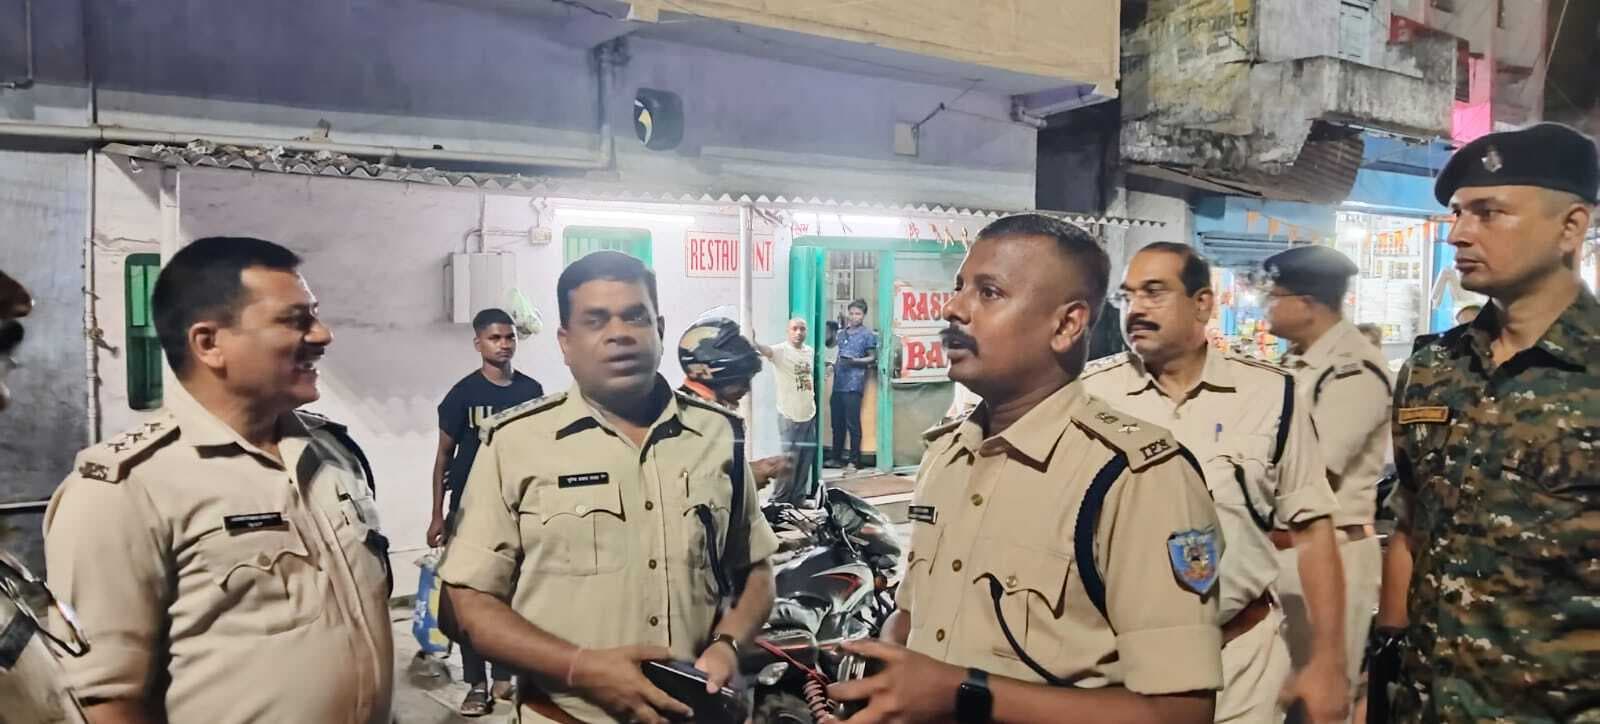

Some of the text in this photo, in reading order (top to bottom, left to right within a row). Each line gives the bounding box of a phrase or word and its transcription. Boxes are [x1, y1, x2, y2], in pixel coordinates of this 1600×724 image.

[690, 238, 772, 272] RESTAUNT
[906, 341, 948, 370] BA
[1139, 439, 1171, 461] IPS
